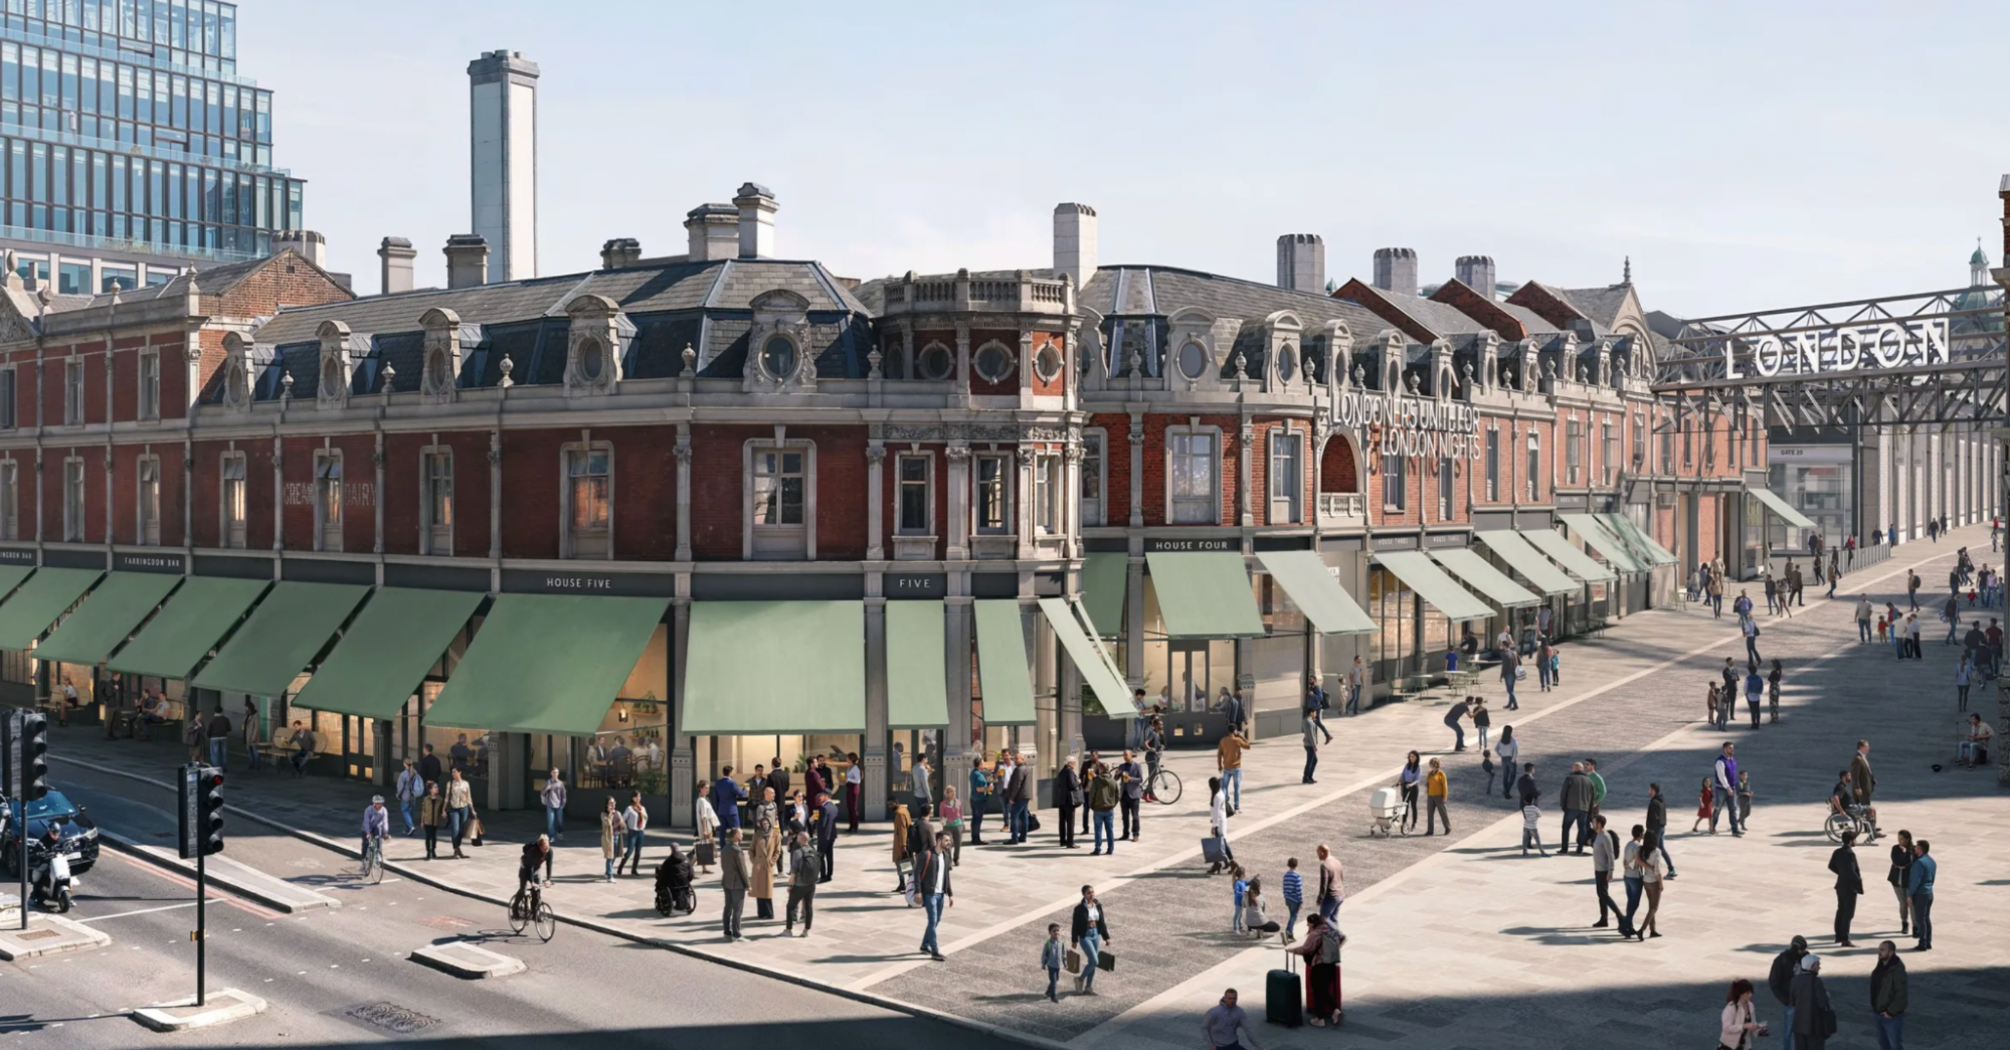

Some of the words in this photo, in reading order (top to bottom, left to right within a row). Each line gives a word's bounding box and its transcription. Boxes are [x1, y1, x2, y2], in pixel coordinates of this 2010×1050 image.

[1726, 318, 1950, 380] LONDON
[1333, 393, 1418, 429] LONDONERS
[1420, 400, 1456, 432] UNITE
[1458, 404, 1480, 433] FOR
[1382, 428, 1437, 458] LONDON
[1440, 431, 1480, 460] NIGHTS
[344, 482, 377, 506] DAIRY
[1378, 537, 1393, 546] HOUSE
[1395, 536, 1409, 545] THREE
[1433, 535, 1447, 543] HOUSE
[1156, 541, 1193, 550] HOUSE
[1199, 541, 1228, 550] FOUR
[22, 552, 33, 560] BAR
[124, 556, 165, 567] FARRINGDON
[167, 558, 180, 568] BAR
[547, 577, 582, 588] HOUSE
[587, 578, 612, 589] FIVE
[899, 578, 931, 588] FIVE
